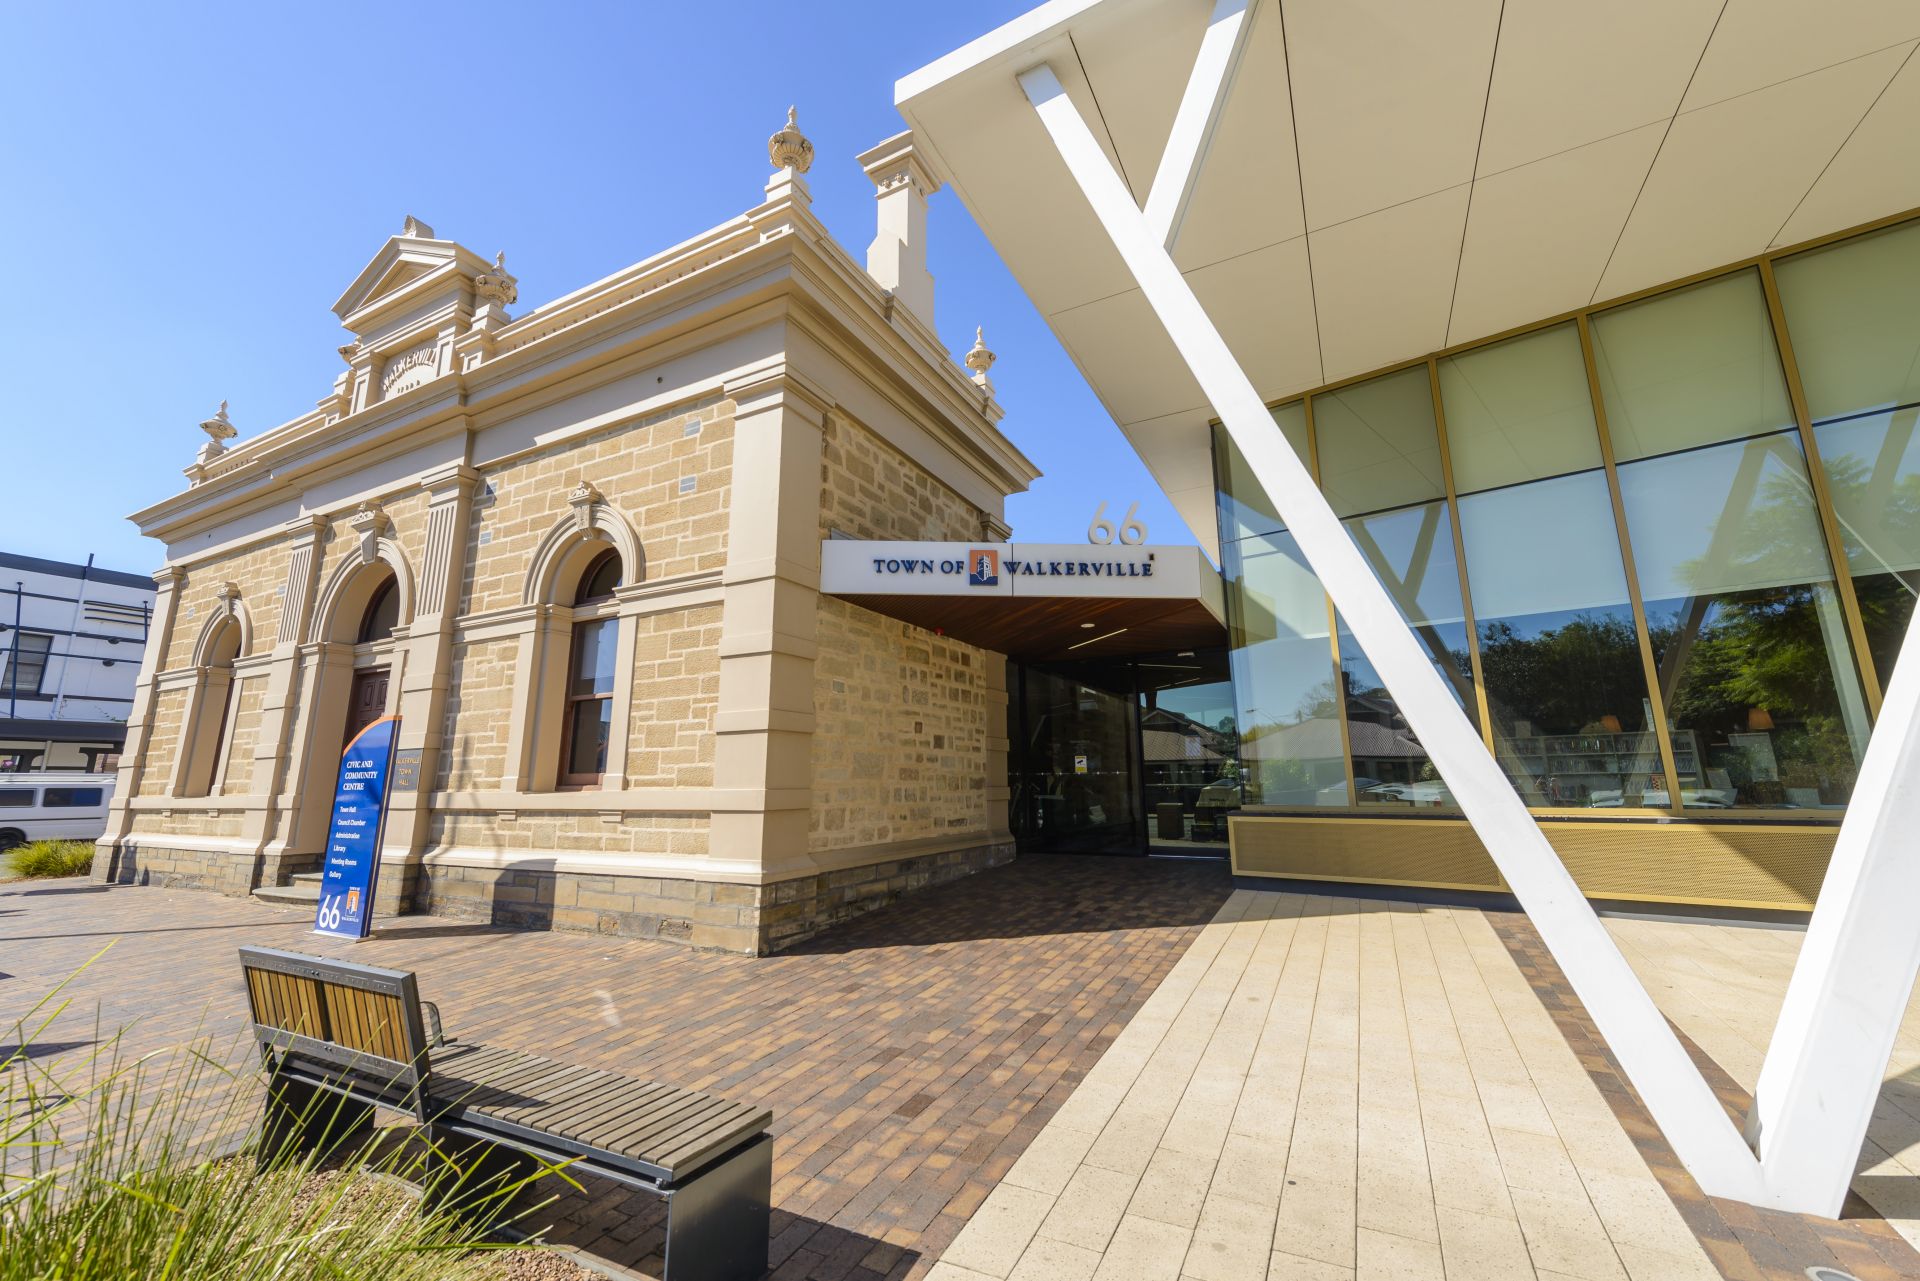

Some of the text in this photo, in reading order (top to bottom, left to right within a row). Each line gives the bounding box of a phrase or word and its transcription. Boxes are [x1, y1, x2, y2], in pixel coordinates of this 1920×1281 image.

[383, 348, 435, 392] WALKERVILL
[1088, 501, 1147, 545] 66
[873, 559, 1154, 577] TOWN OF WALKERVILLE
[346, 760, 373, 769] CIVIC AND
[344, 771, 378, 780] COMMUNITY
[343, 782, 365, 790] CENTRE
[333, 845, 347, 853] Library
[319, 895, 341, 929] 66
